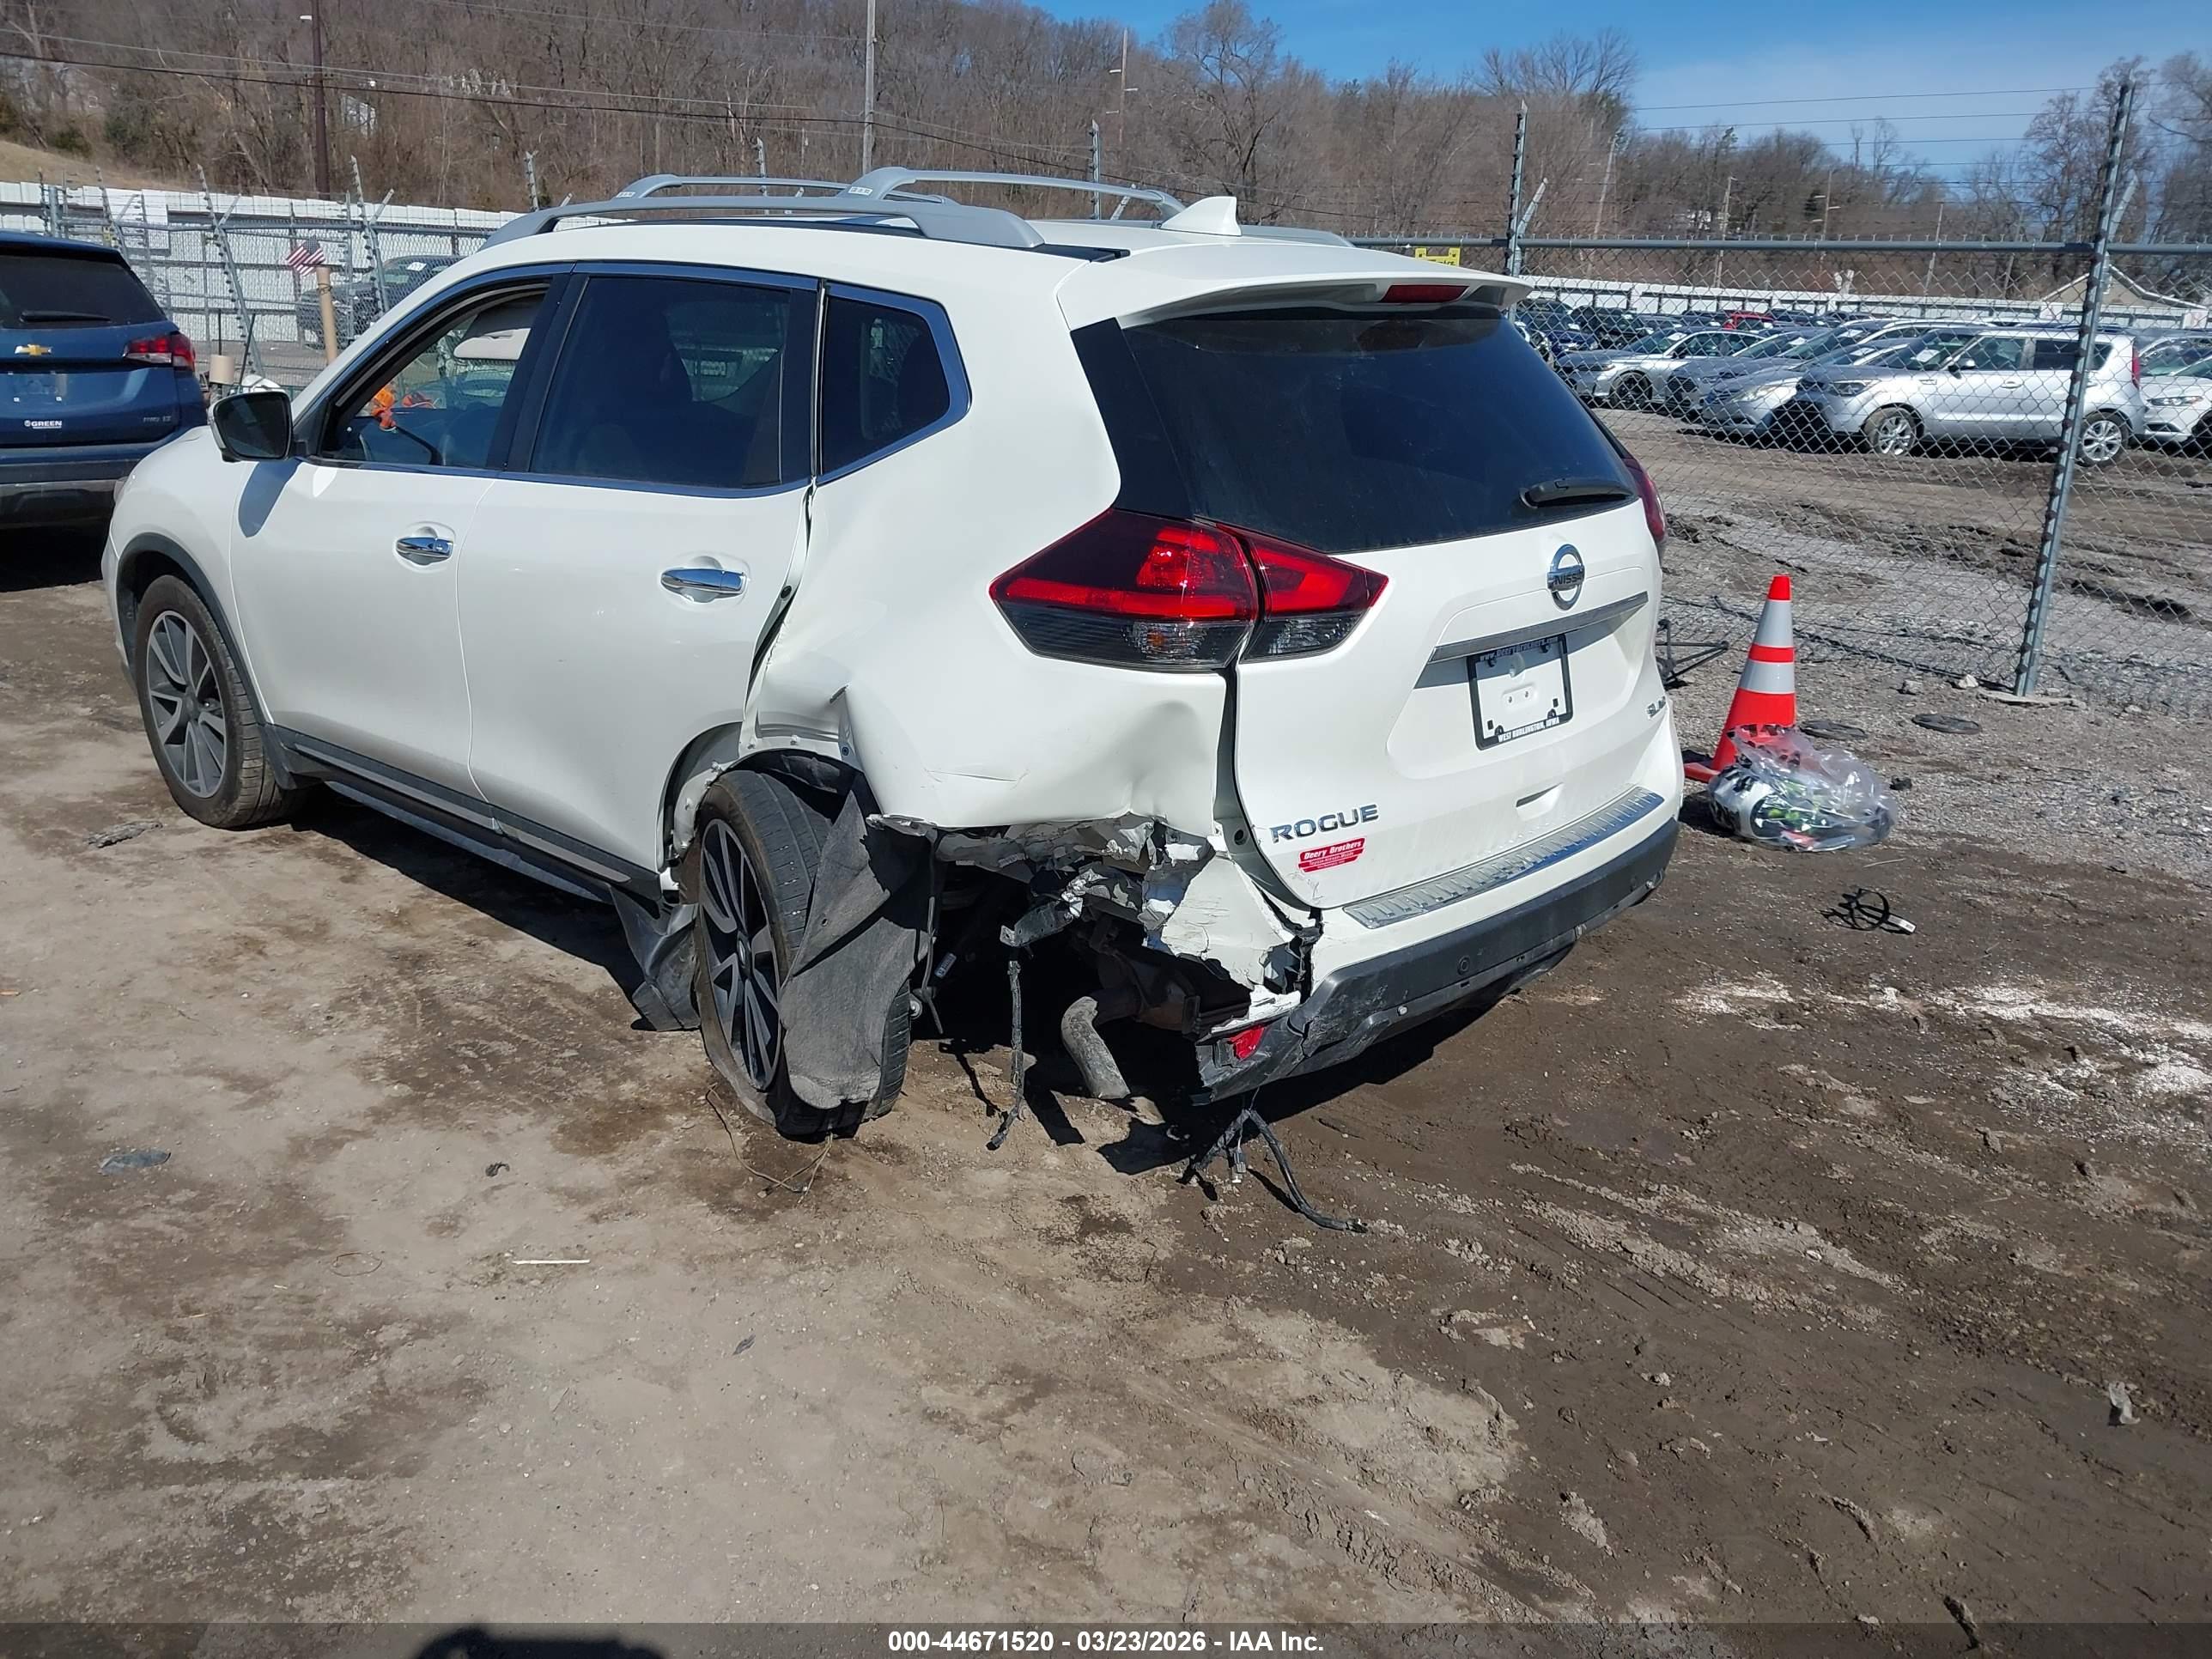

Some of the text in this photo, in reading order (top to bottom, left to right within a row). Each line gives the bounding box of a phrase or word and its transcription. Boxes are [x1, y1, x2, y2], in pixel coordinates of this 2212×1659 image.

[1498, 731, 1512, 743] WEST
[1269, 804, 1379, 844] ROGUE
[1329, 841, 1362, 854] Brothers
